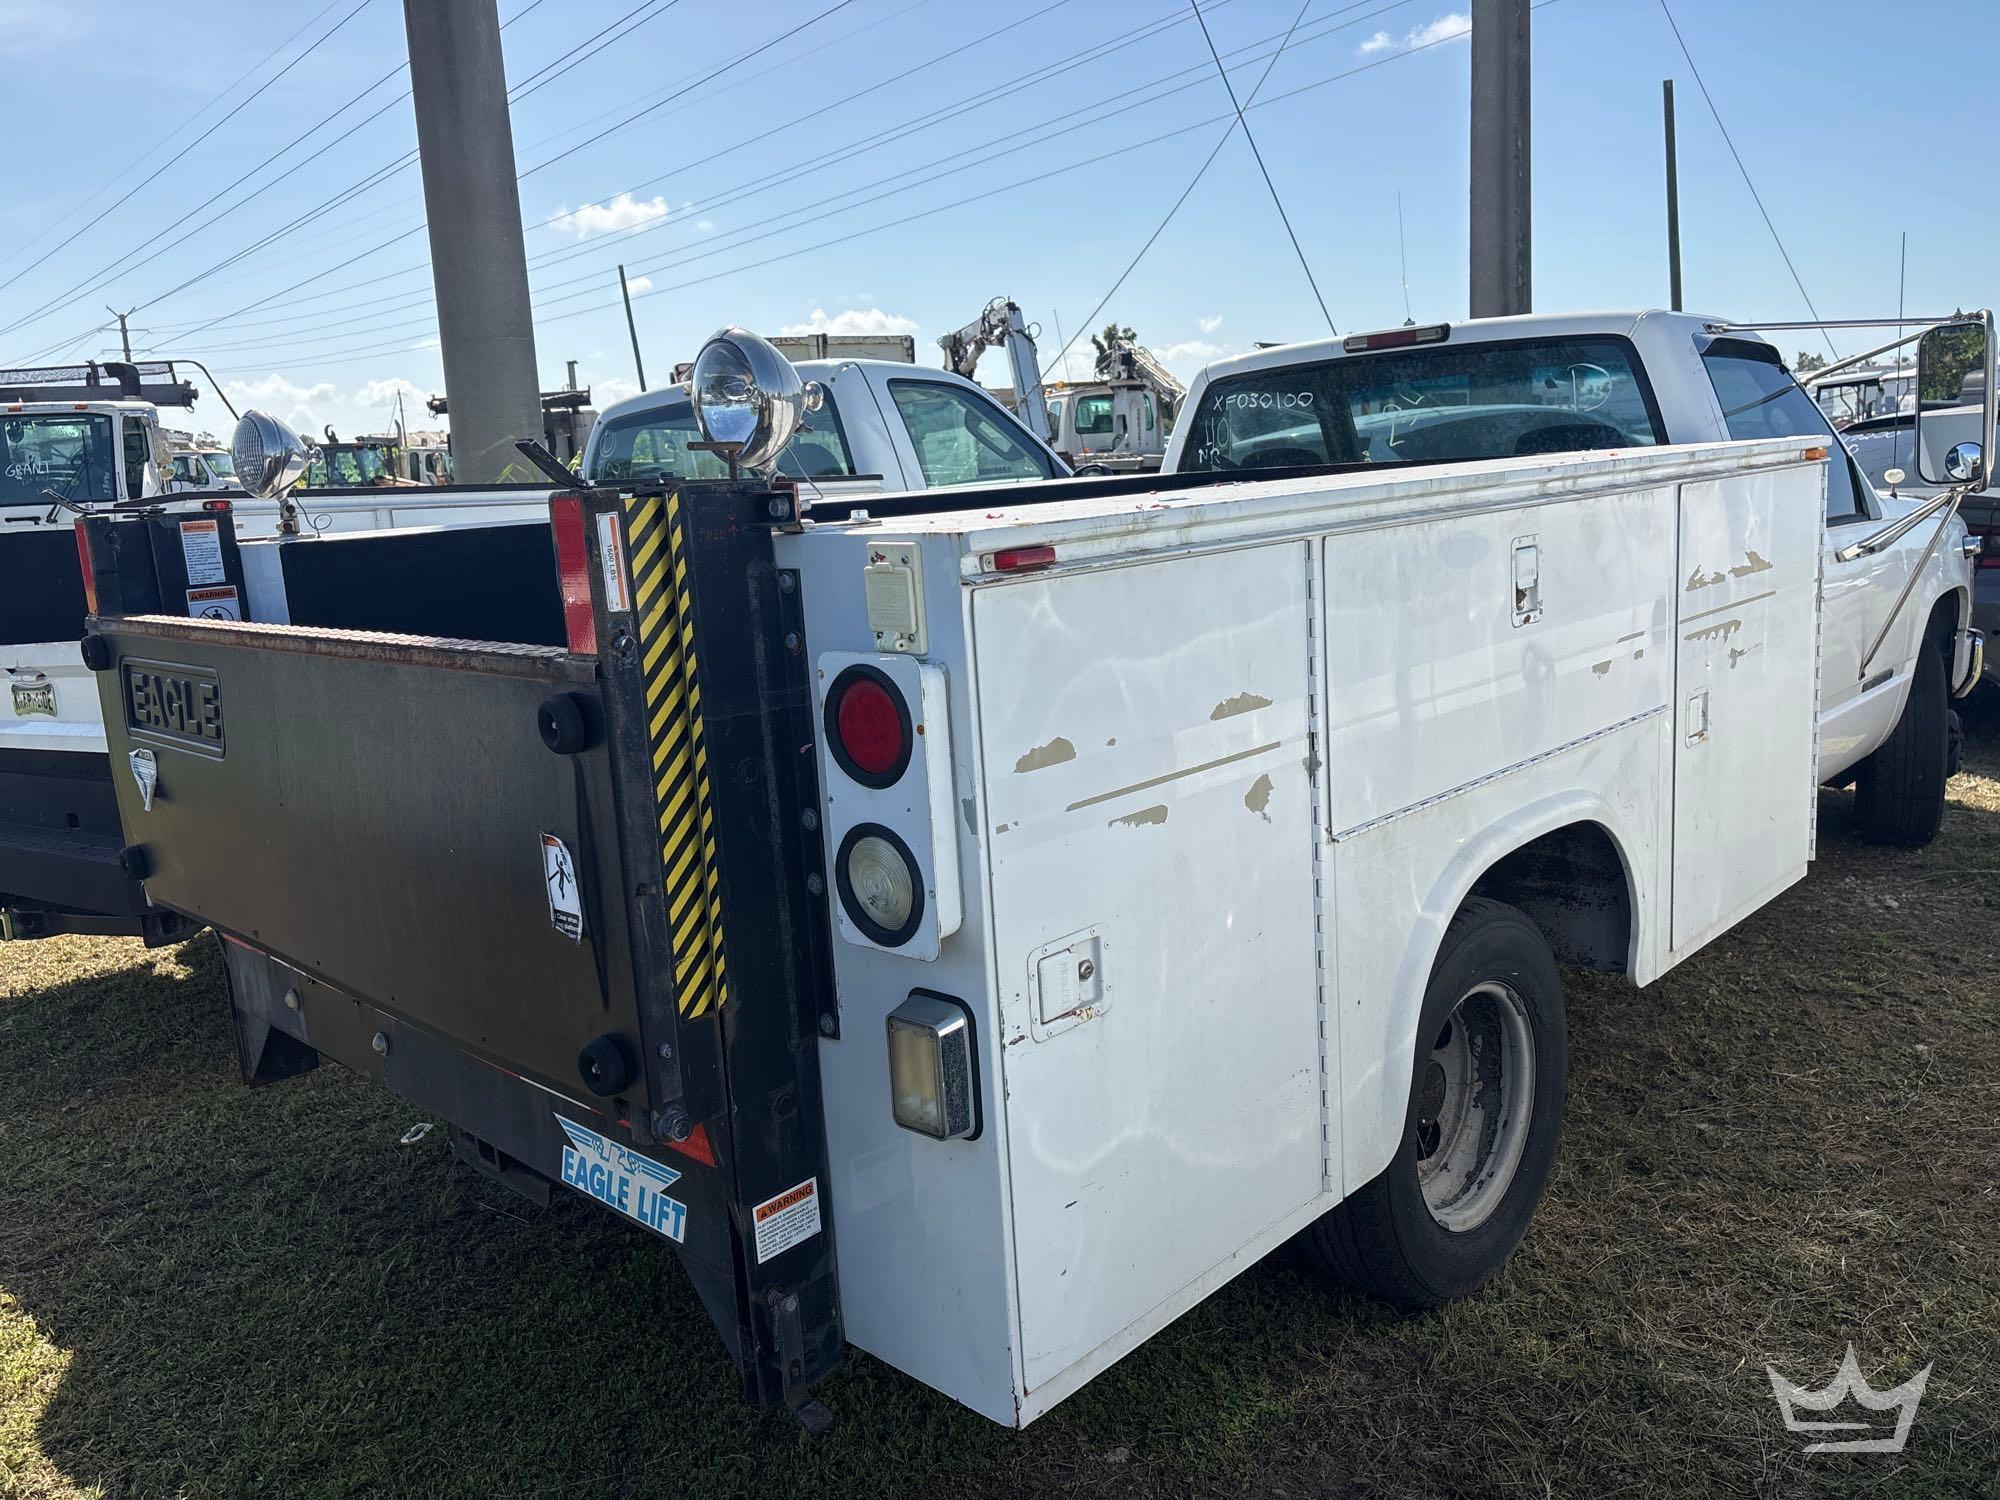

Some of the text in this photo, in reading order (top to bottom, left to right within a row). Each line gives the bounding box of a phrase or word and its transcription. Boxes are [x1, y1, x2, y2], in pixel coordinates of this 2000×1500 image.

[1213, 391, 1314, 412] XF030100
[1198, 447, 1221, 464] NR
[606, 543, 617, 581] 1600 LBS
[198, 590, 234, 599] WARNING
[131, 672, 222, 739] EAGLE
[563, 1147, 686, 1240] EAGLE LIFT
[767, 1185, 812, 1213] WARNING
